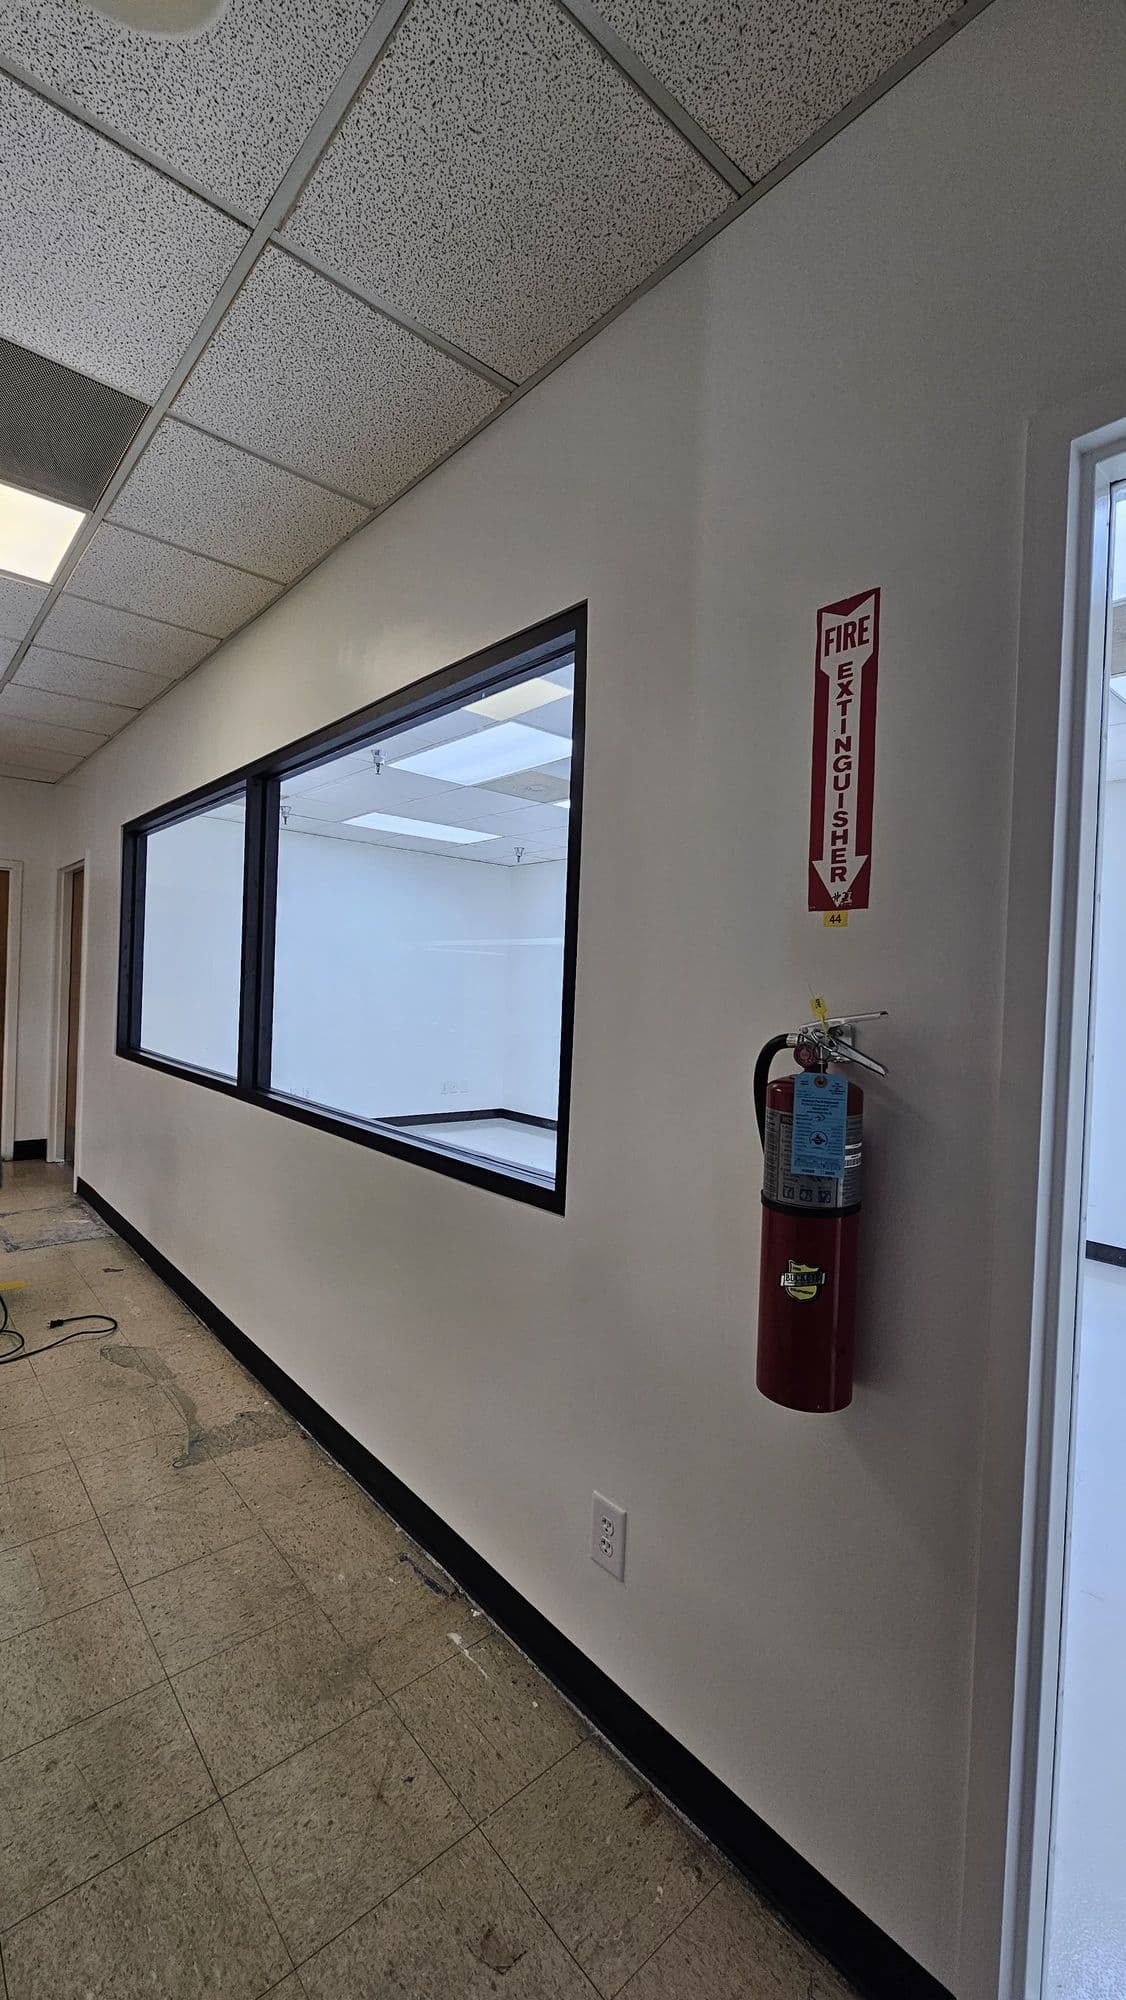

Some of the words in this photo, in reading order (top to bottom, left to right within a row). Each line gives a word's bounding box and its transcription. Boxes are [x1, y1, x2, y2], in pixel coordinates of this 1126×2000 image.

[824, 615, 870, 657] FIRE
[830, 661, 853, 883] EXTINGUISHER
[829, 914, 842, 924] 44
